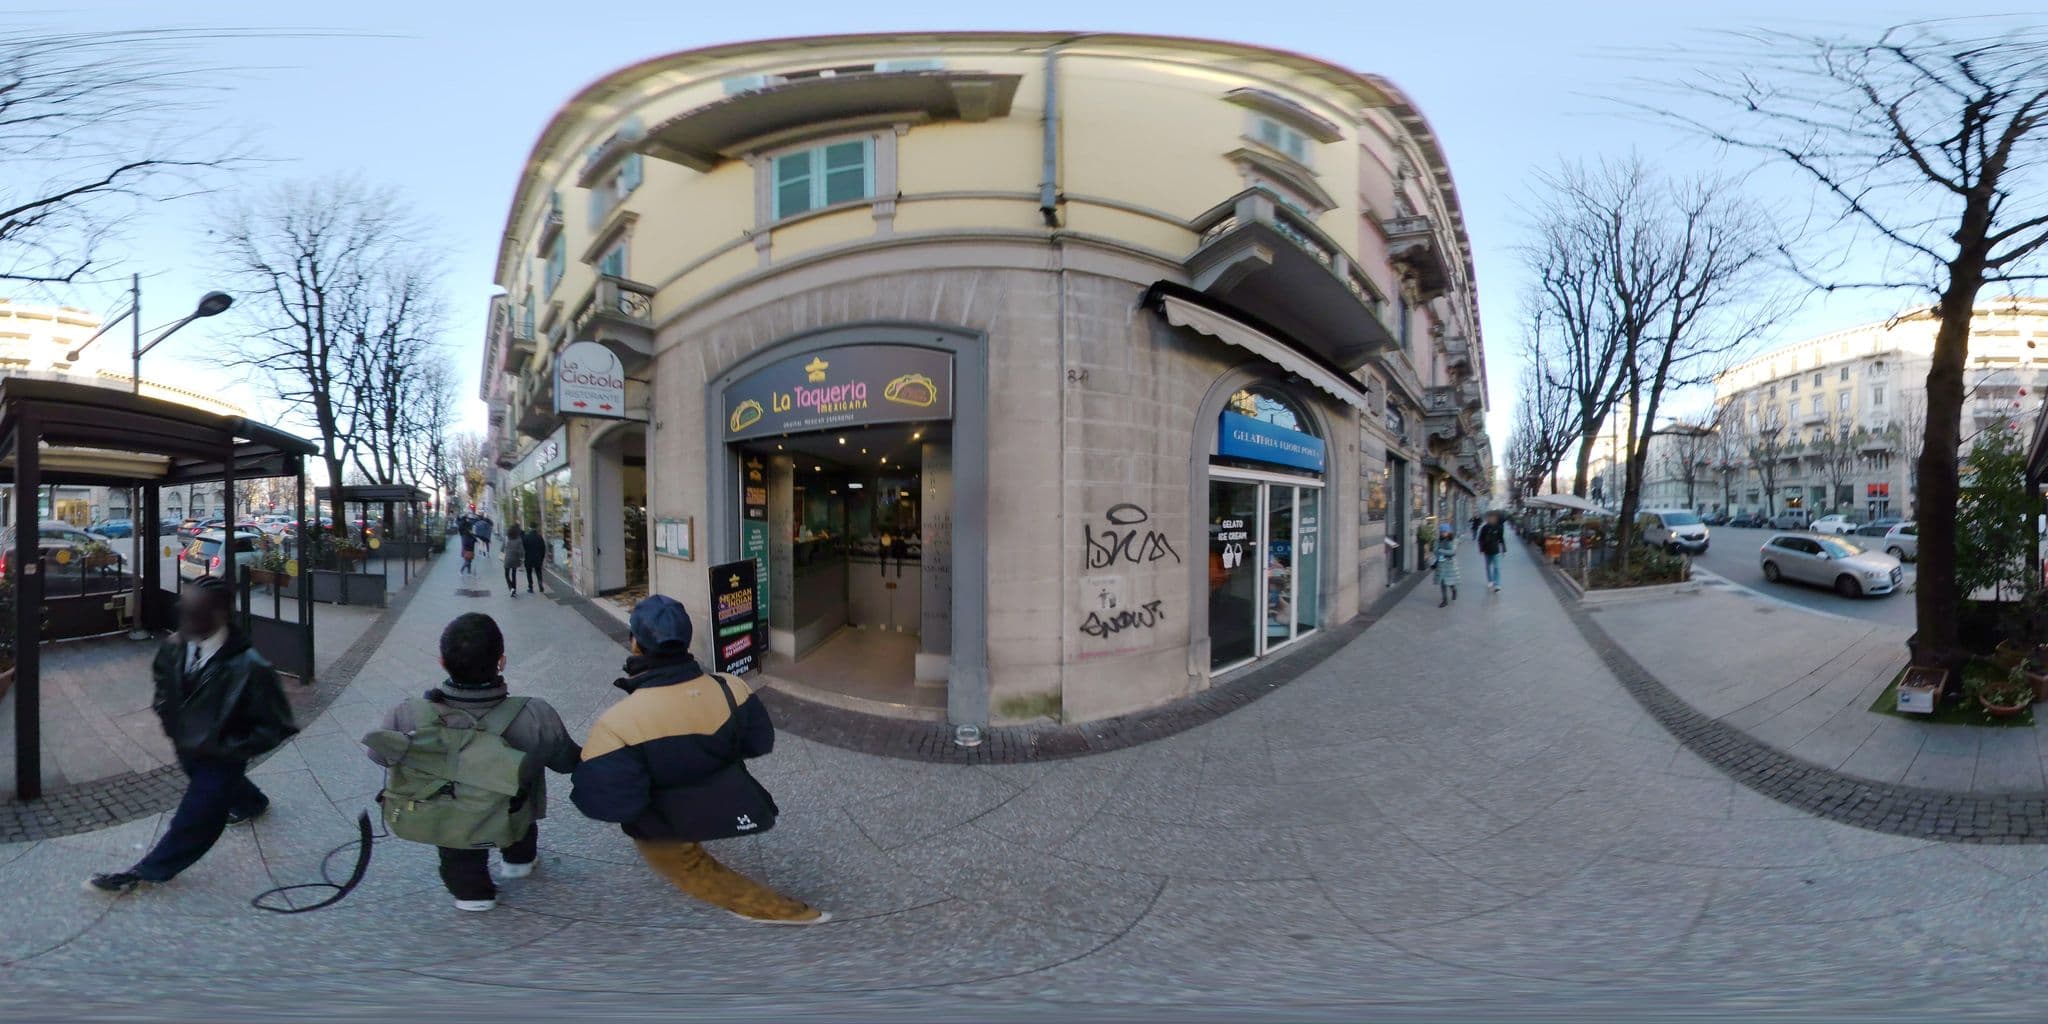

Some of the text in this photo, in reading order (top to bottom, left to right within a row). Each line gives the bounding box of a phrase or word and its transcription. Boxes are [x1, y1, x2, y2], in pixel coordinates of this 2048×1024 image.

[563, 360, 579, 370] La
[560, 369, 624, 390] Ciotola
[564, 389, 620, 403] RISTORANTE
[772, 379, 867, 415] La Taqueria
[819, 399, 868, 414] MEXICANA
[1233, 429, 1278, 448] GELATERIA
[1222, 519, 1244, 529] GELATO
[1228, 531, 1248, 540] CREAM
[719, 587, 752, 604] MEXICAN
[728, 595, 753, 609] INDIAN
[727, 655, 752, 672] APERTO
[731, 664, 749, 677] OPEN
